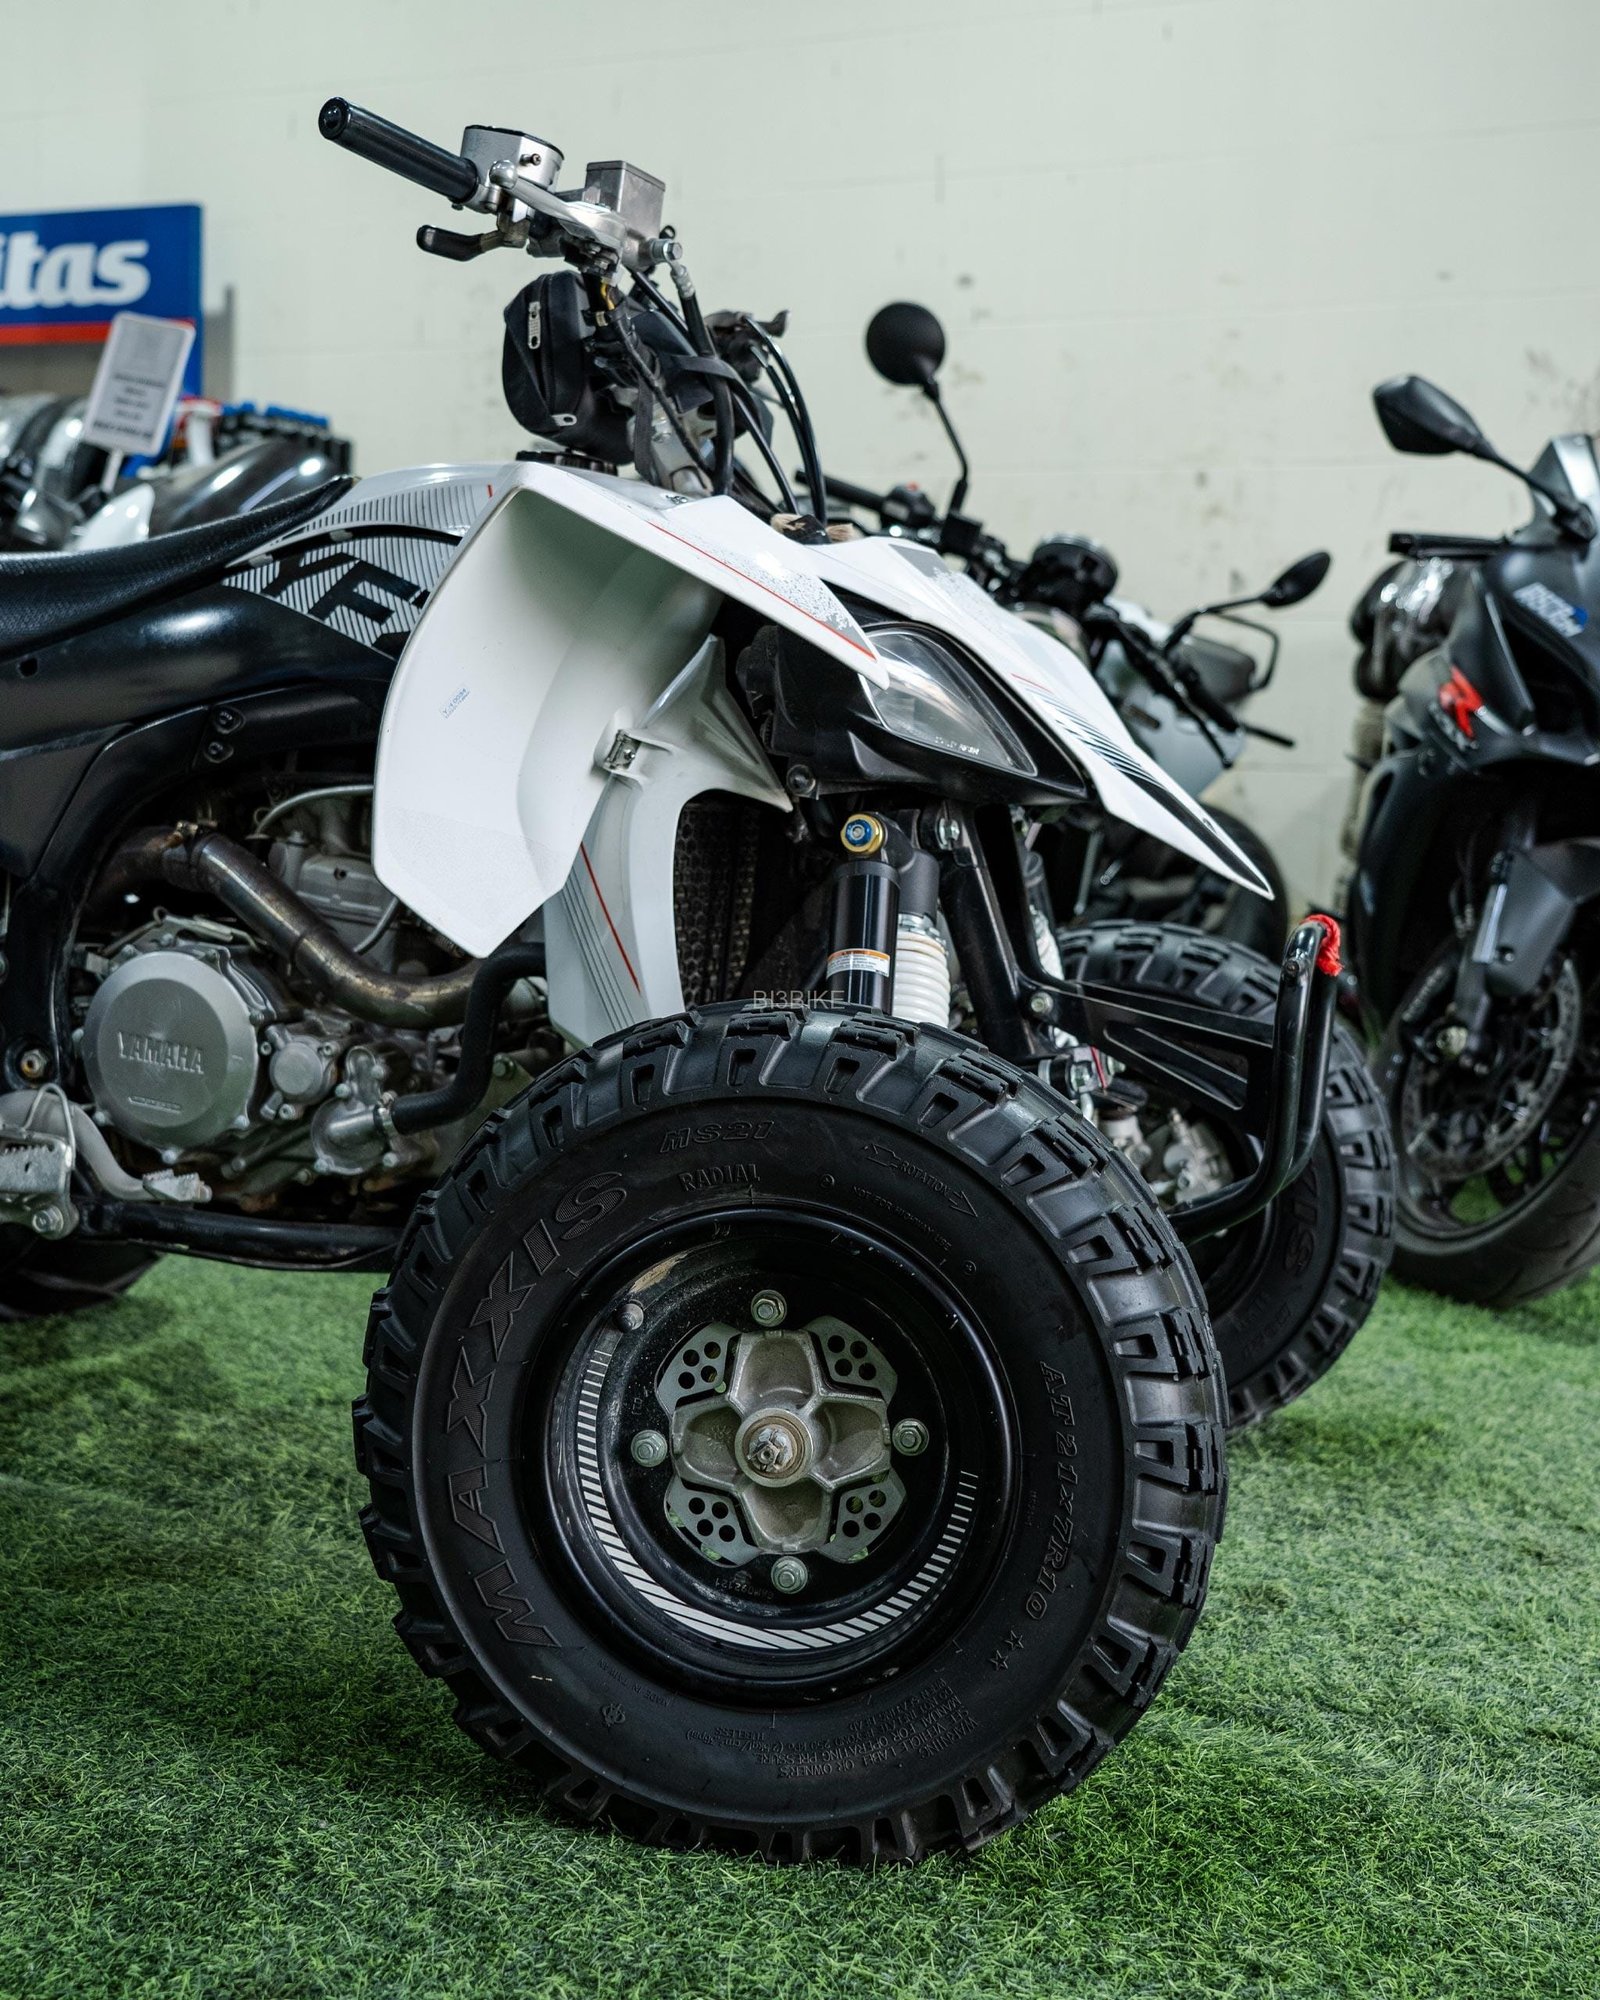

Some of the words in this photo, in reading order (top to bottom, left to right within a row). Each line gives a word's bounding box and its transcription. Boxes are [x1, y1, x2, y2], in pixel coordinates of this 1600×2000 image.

[117, 1031, 205, 1075] YAMAHA
[659, 1119, 775, 1153] MS21
[678, 1163, 761, 1192] RADIAL
[900, 1159, 951, 1197] ROTATION
[447, 1172, 628, 1649] MAXXIS
[821, 1736, 889, 1764] OPERATING
[891, 1722, 917, 1743] FOR
[919, 1716, 979, 1760] WARNING
